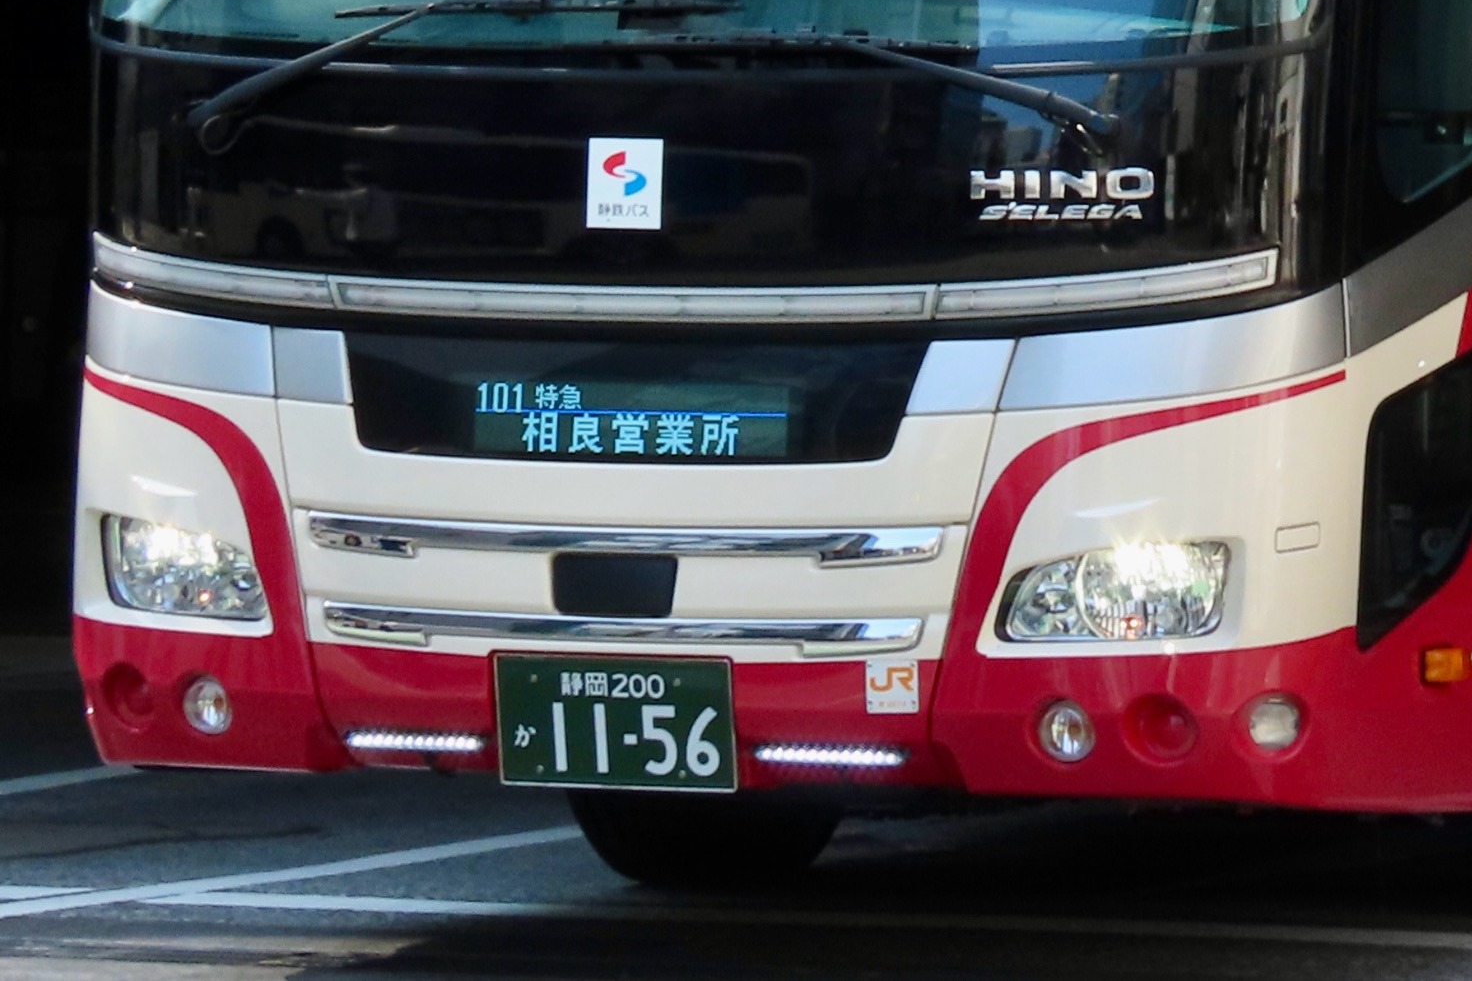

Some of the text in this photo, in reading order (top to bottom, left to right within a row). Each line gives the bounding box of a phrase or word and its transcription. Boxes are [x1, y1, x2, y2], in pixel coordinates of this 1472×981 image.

[969, 167, 1155, 200] HINO
[476, 381, 582, 414] 101 特急
[521, 411, 742, 456] 相良営業所
[869, 666, 914, 692] JR
[551, 701, 722, 778] 11-56
